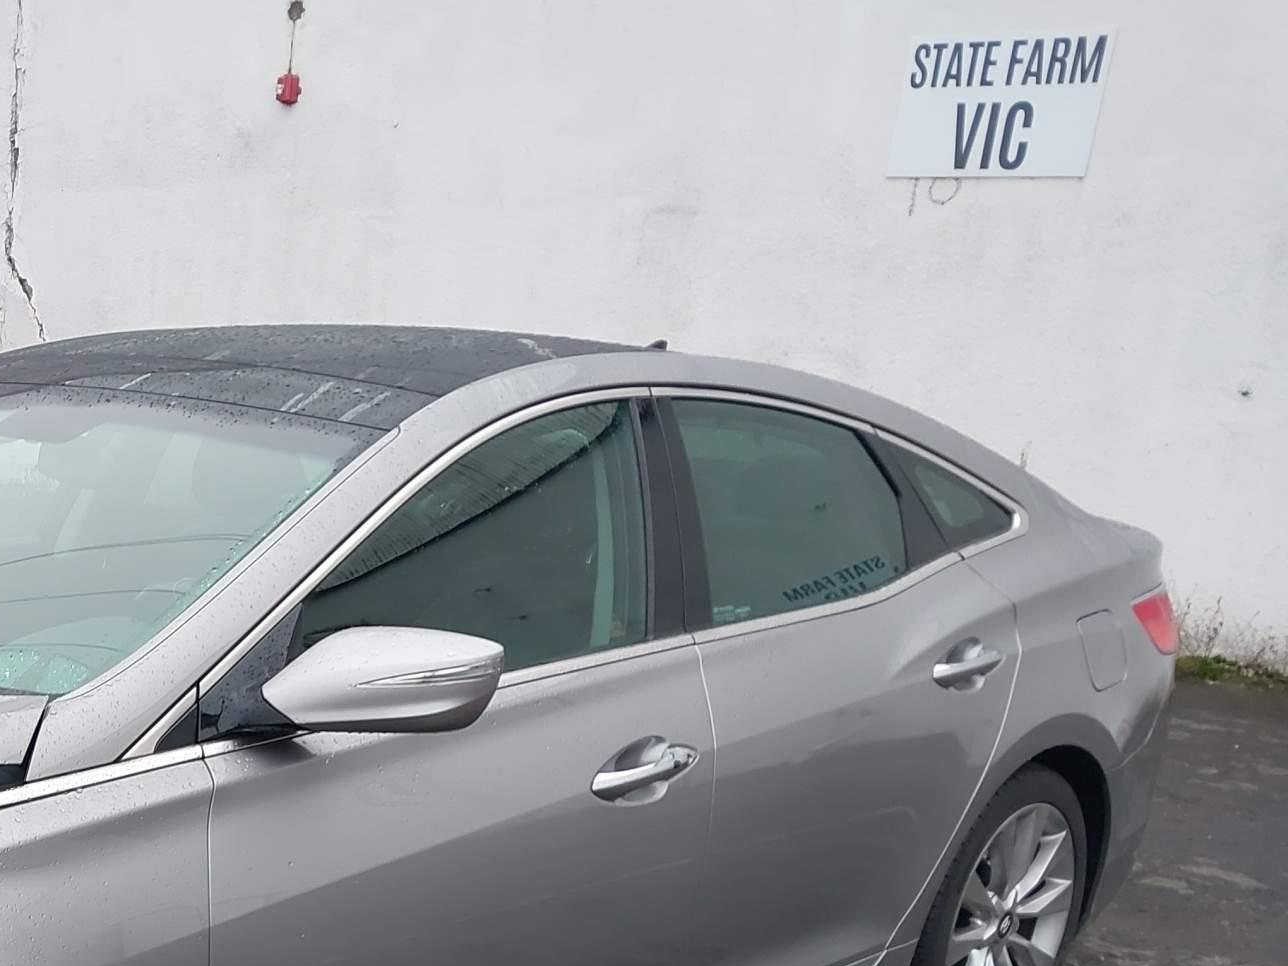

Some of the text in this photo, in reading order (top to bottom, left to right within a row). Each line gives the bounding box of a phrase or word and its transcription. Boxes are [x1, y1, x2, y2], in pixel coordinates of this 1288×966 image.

[910, 35, 1108, 89] STATE FARM
[953, 100, 1035, 171] VIC
